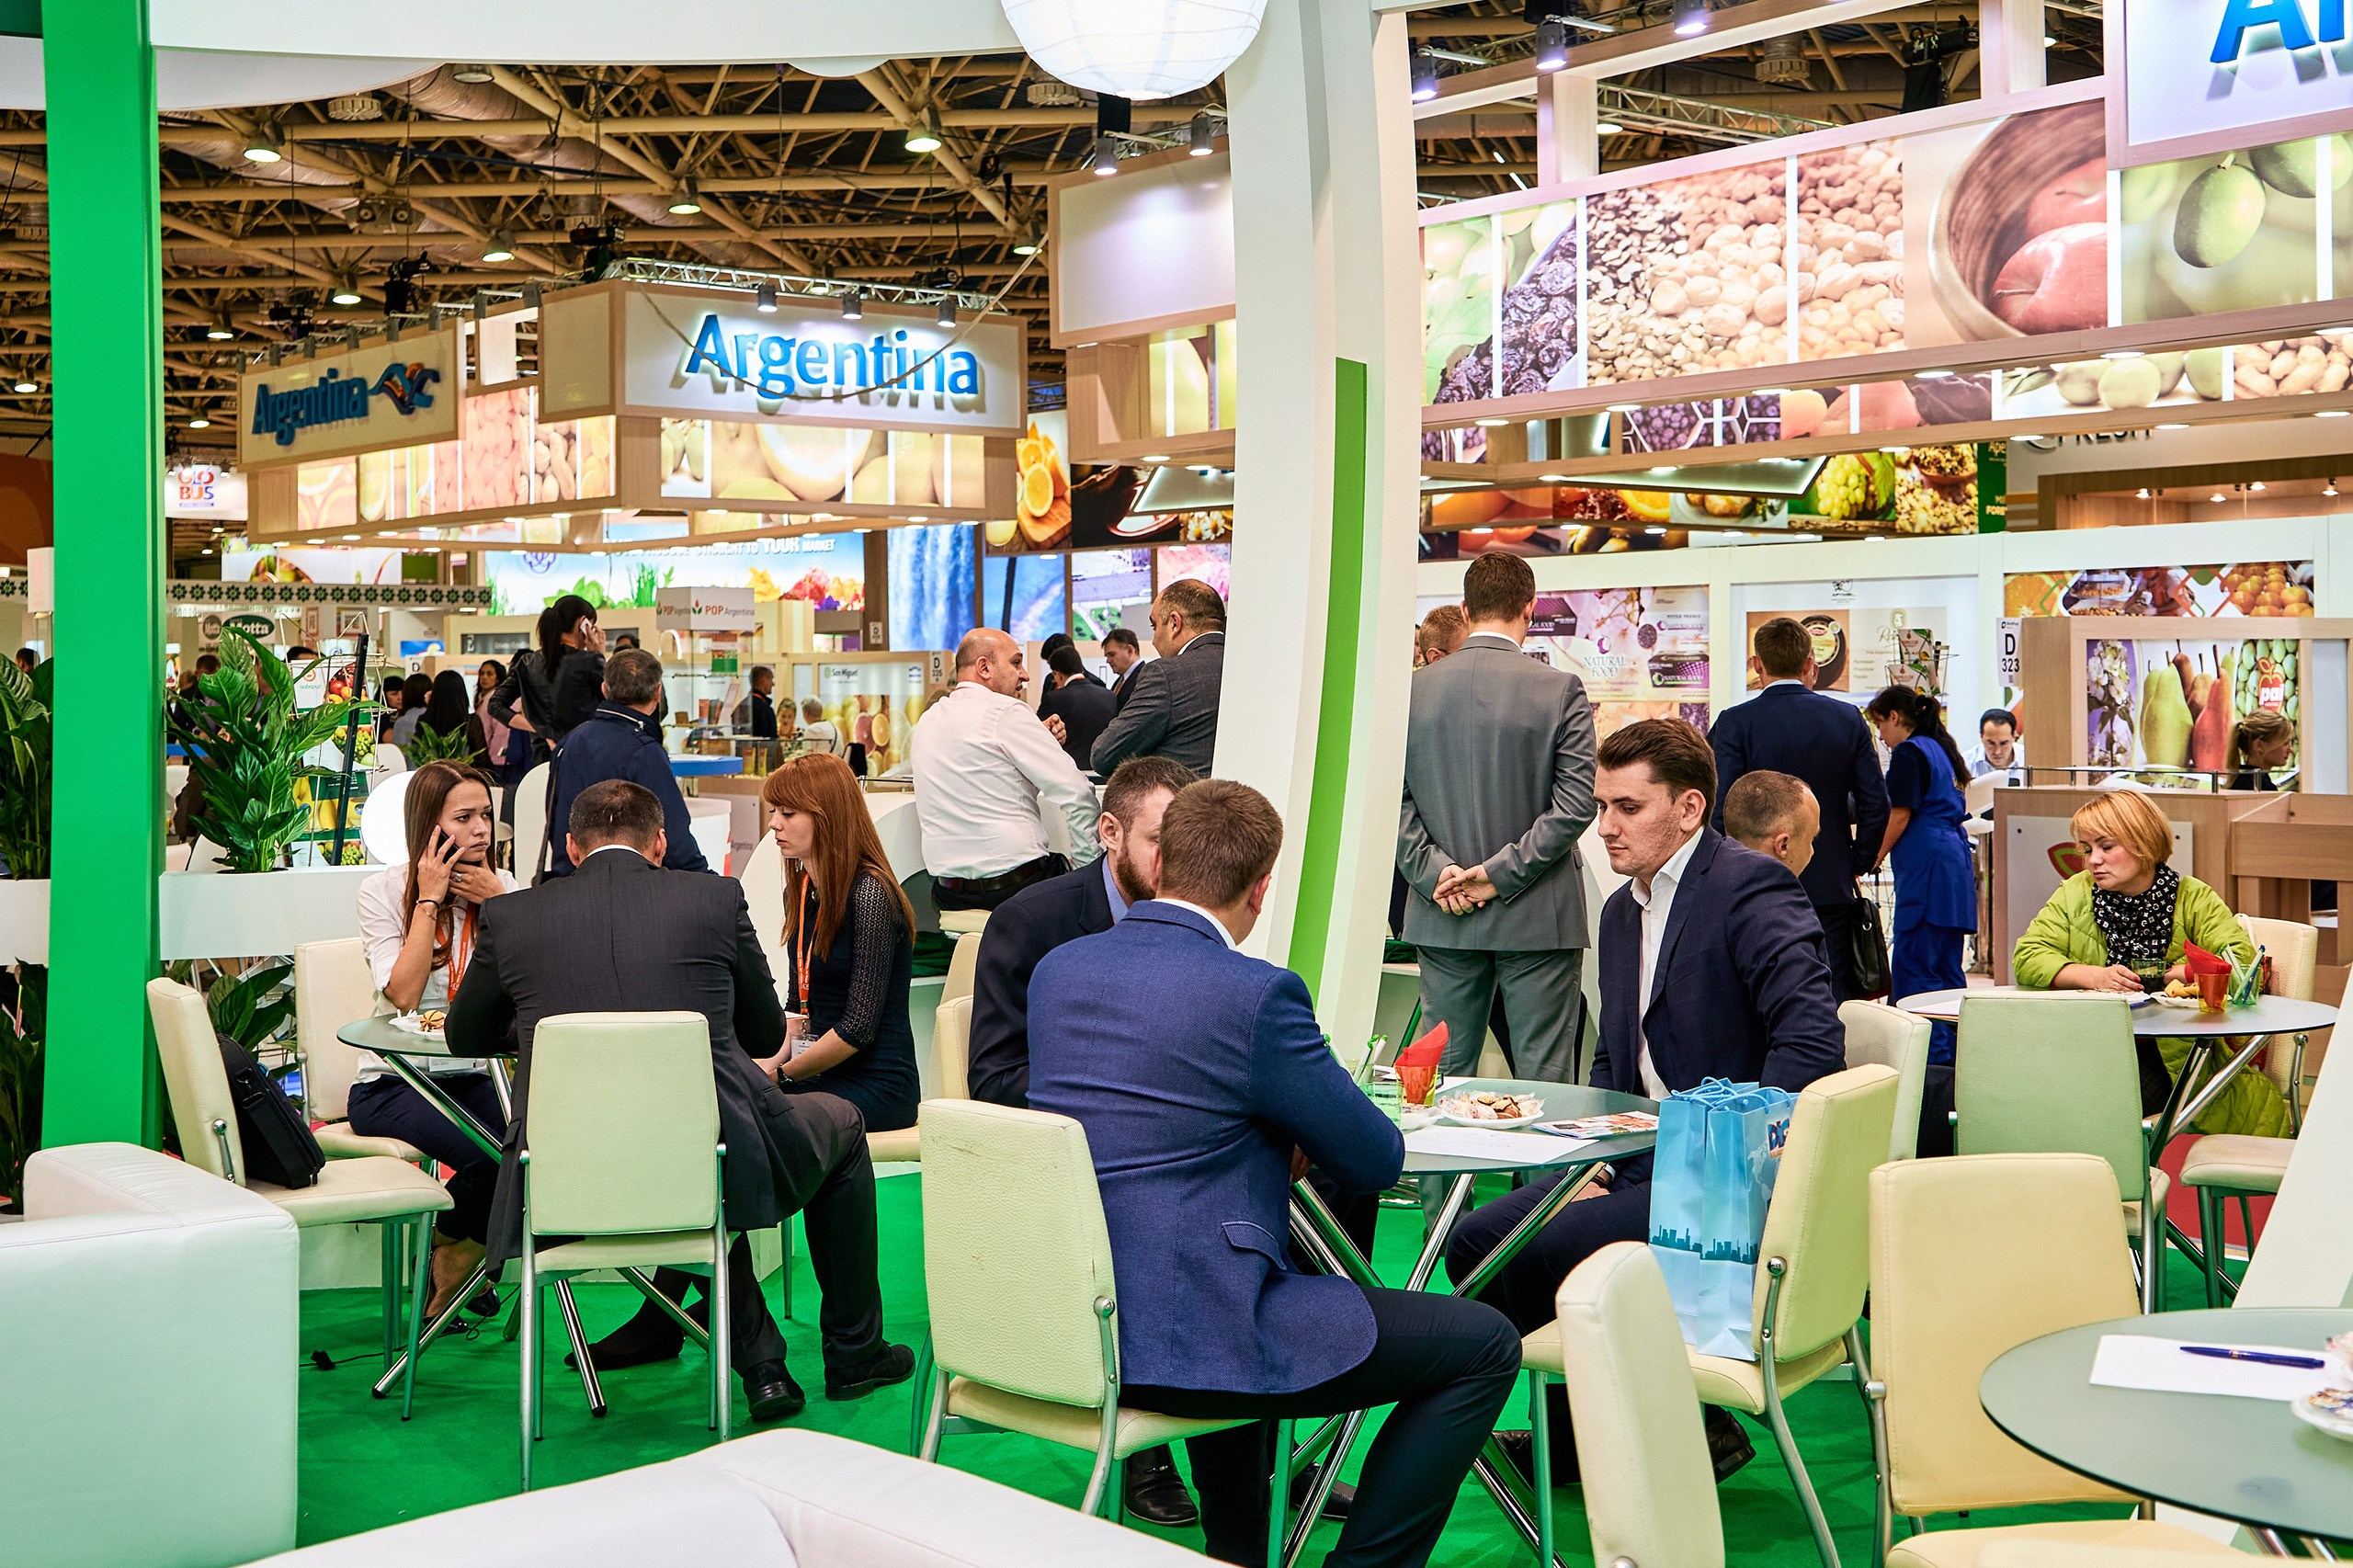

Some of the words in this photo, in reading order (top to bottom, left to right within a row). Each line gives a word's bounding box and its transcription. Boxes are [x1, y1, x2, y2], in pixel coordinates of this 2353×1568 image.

[686, 314, 979, 400] Argentina
[252, 368, 369, 446] Argentina
[179, 485, 214, 500] BUS
[705, 606, 724, 615] POP
[724, 608, 755, 619] Argentina
[2005, 633, 2016, 655] D
[933, 657, 941, 669] D
[1584, 656, 1626, 667] NATURAL
[2001, 658, 2020, 673] 323
[1592, 667, 1619, 677] FOOD
[2259, 684, 2285, 706] pai
